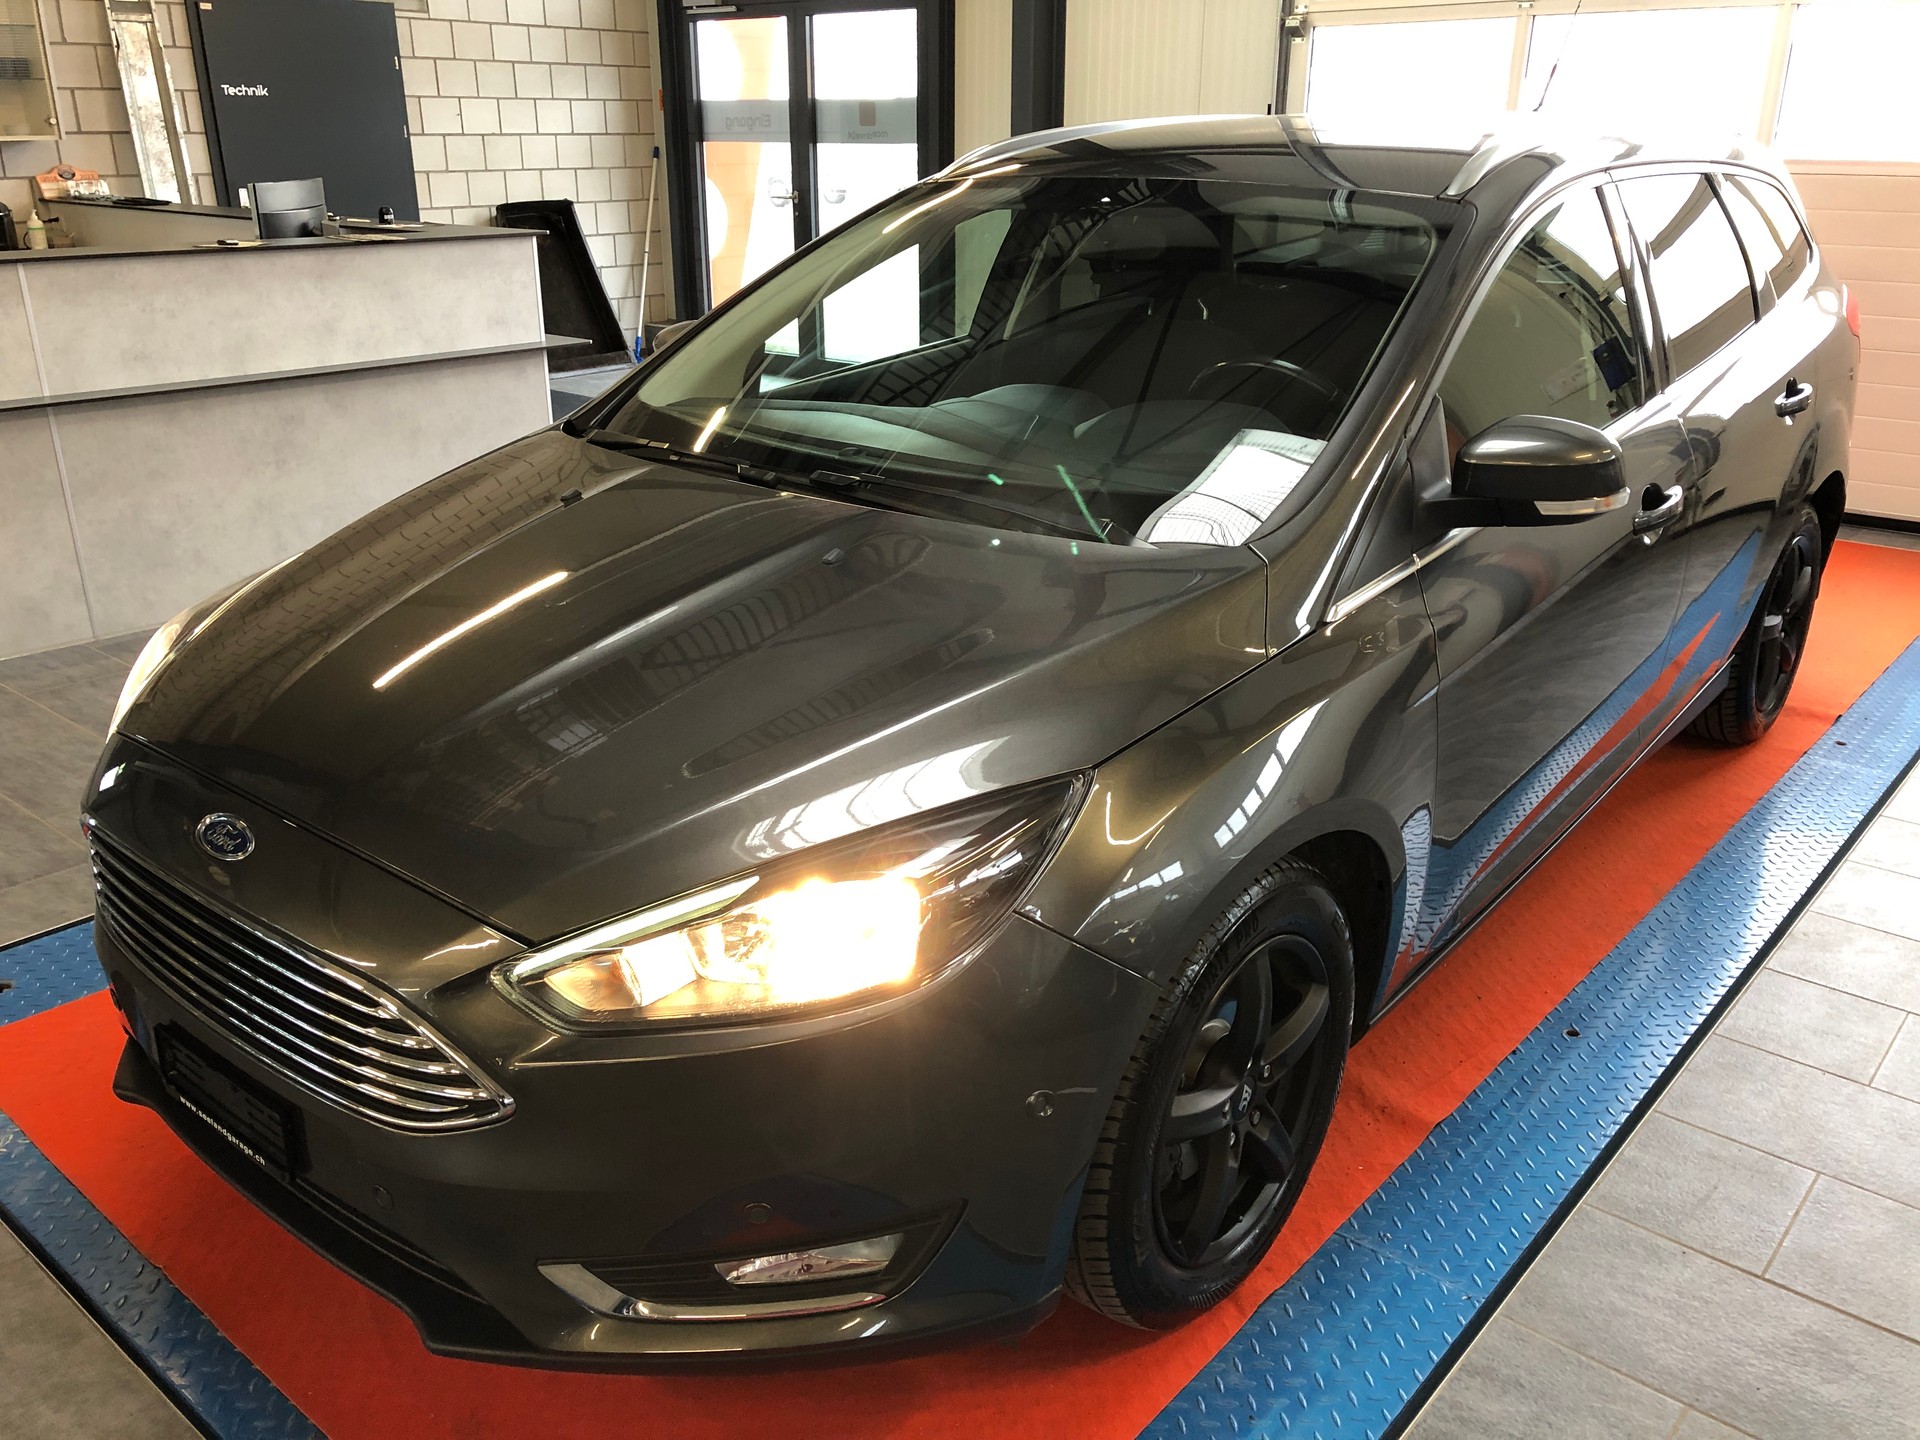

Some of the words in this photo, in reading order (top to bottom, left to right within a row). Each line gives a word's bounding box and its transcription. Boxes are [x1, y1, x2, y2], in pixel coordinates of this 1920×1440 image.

[220, 84, 269, 97] Technik
[206, 822, 242, 852] Ford
[179, 1094, 266, 1166] www.seelandgarage.ch
